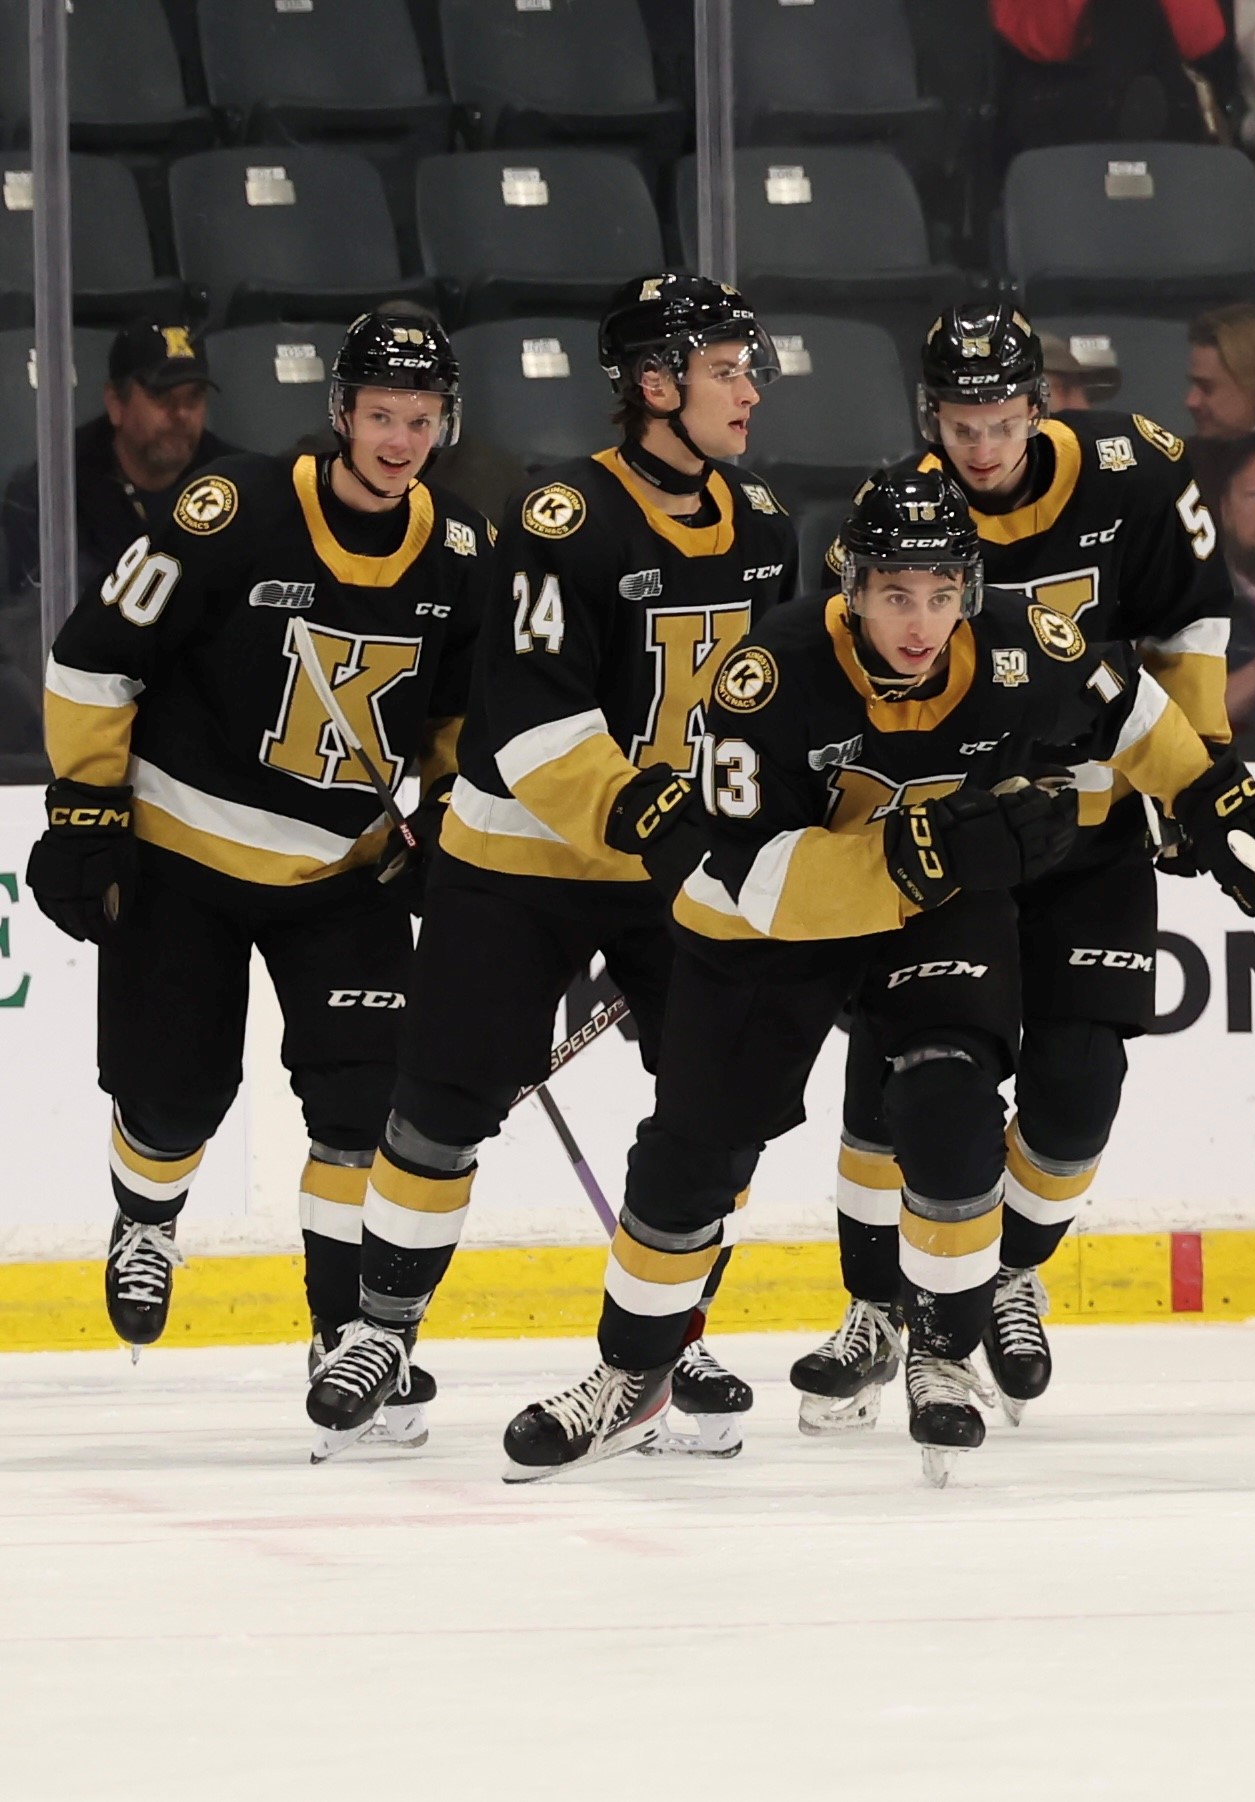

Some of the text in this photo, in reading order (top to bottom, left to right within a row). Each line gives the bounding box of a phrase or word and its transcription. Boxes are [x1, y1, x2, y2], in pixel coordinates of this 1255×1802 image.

[160, 326, 196, 359] K
[961, 337, 991, 358] 55
[388, 357, 433, 369] CCM
[958, 374, 1000, 385] CCM
[1100, 439, 1132, 462] 50
[747, 484, 772, 507] 50
[538, 497, 568, 521] K
[448, 520, 474, 548] 50
[900, 538, 948, 548] CCM
[1078, 519, 1123, 547] CC
[101, 535, 182, 627] 90
[743, 564, 783, 582] CCM
[415, 602, 452, 618] CC
[513, 571, 565, 654] 24
[995, 650, 1024, 676] 50
[731, 664, 760, 692] K
[1086, 660, 1126, 703] 1
[259, 616, 422, 794] K
[702, 733, 761, 818] 13
[50, 807, 130, 828] CCM
[1068, 948, 1153, 972] CCM
[887, 960, 989, 989] CCM
